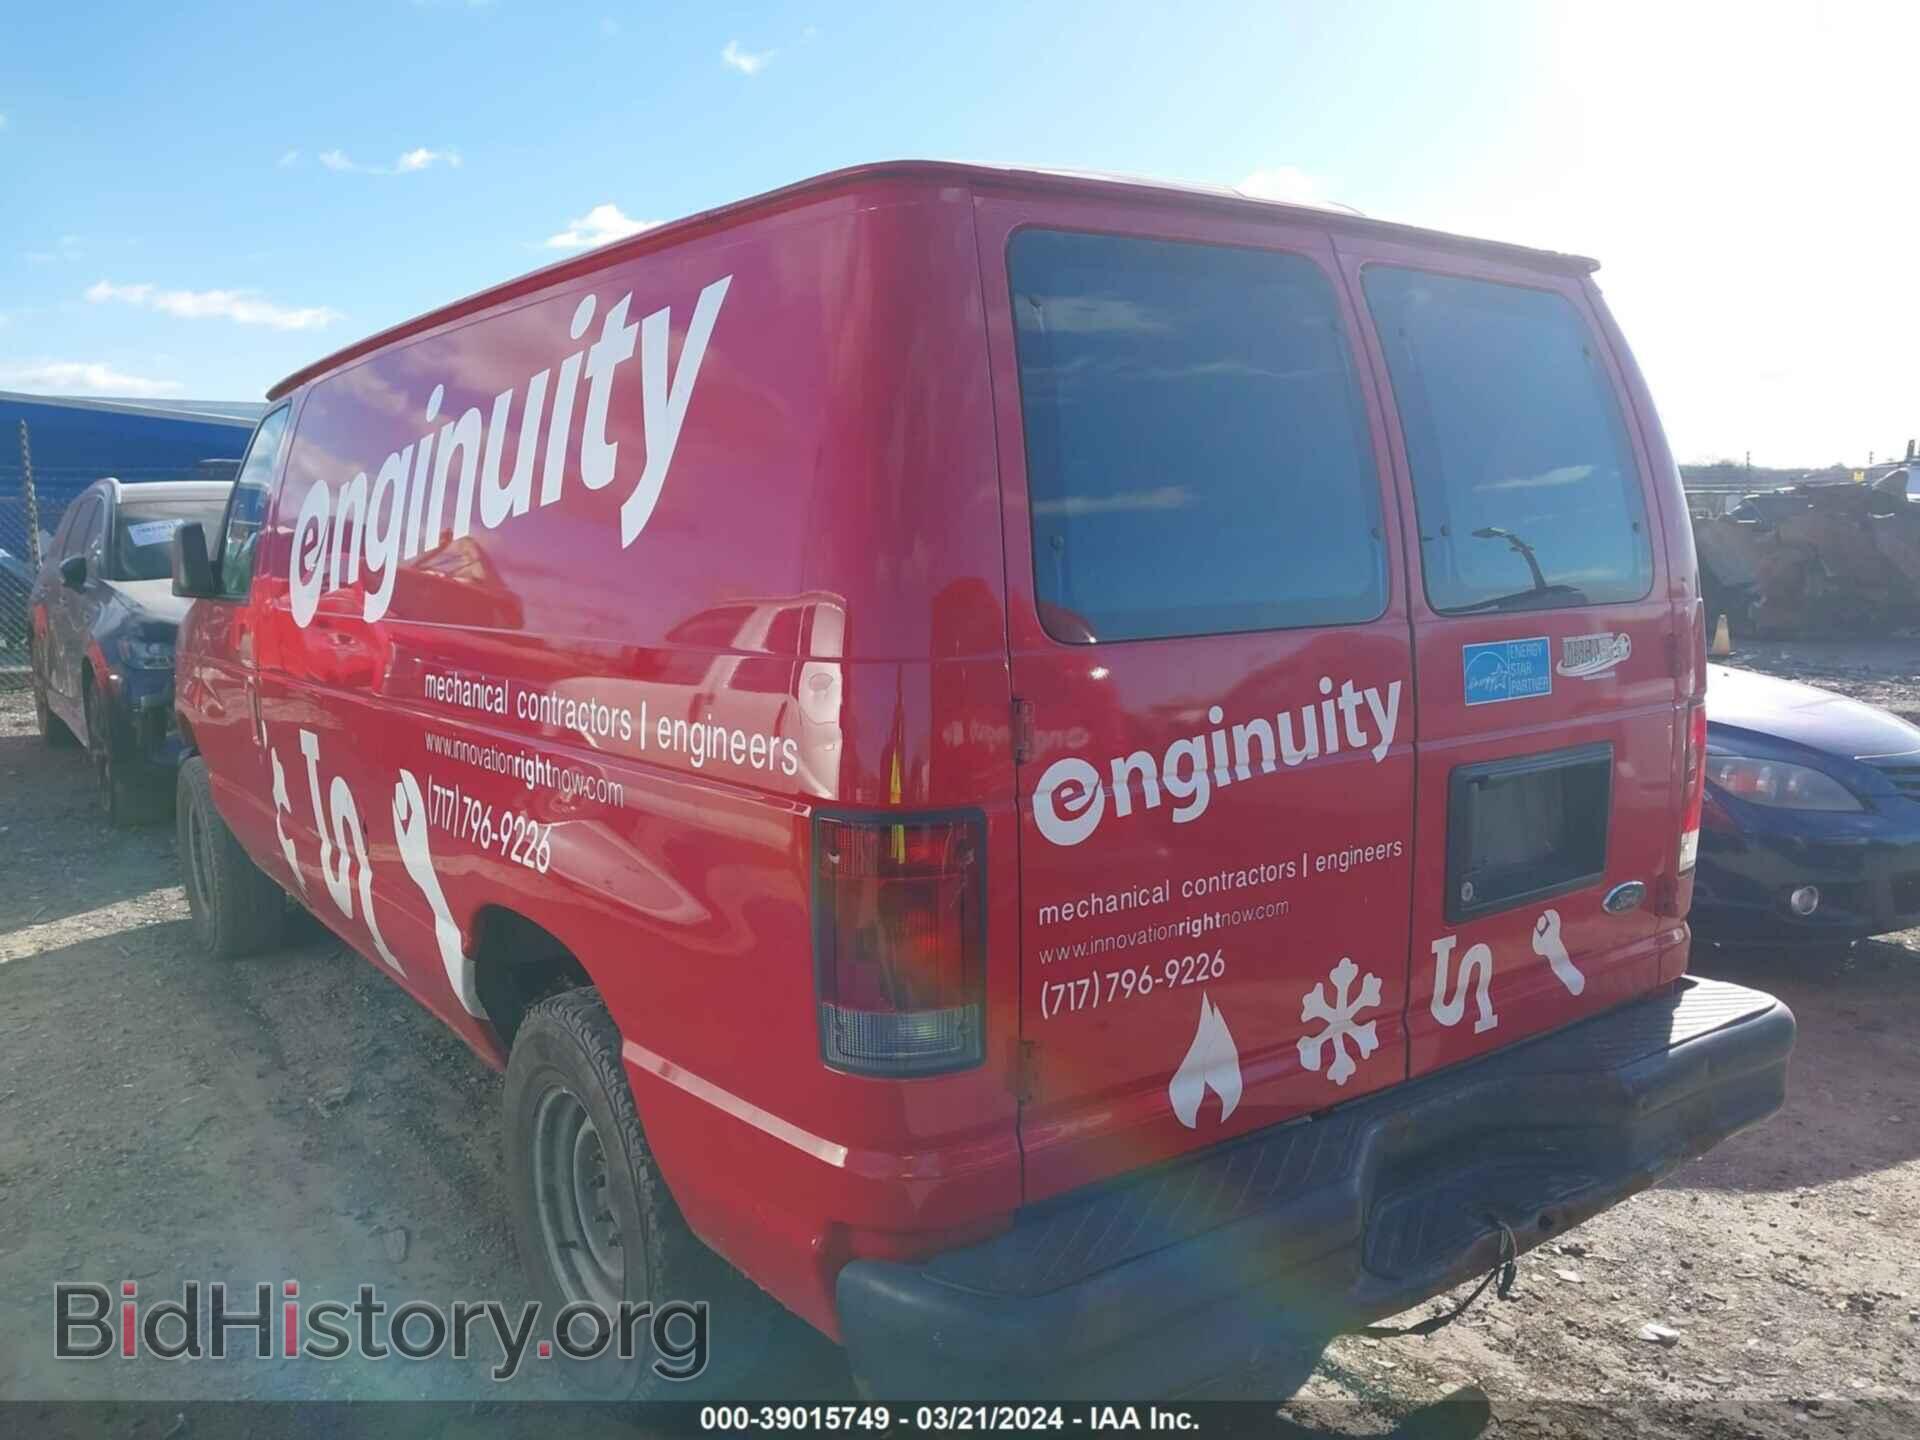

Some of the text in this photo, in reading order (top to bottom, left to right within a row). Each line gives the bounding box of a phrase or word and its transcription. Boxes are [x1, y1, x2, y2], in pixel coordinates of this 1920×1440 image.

[289, 274, 734, 629] enginuity
[1510, 663, 1533, 675] STAR
[425, 672, 508, 714] mechanical
[517, 690, 632, 742] contractors
[657, 713, 799, 776] engineers
[1032, 676, 1403, 847] enginuity
[424, 731, 625, 809] www.innovationrightnow.com
[428, 774, 551, 874] (717) 796-9226
[1038, 880, 1170, 926] mechanical
[1181, 860, 1297, 898] contractors
[1315, 840, 1403, 874] engineers
[1039, 899, 1290, 965] www.innovationrightnow.com
[1040, 949, 1226, 1020] (717) 796-9226
